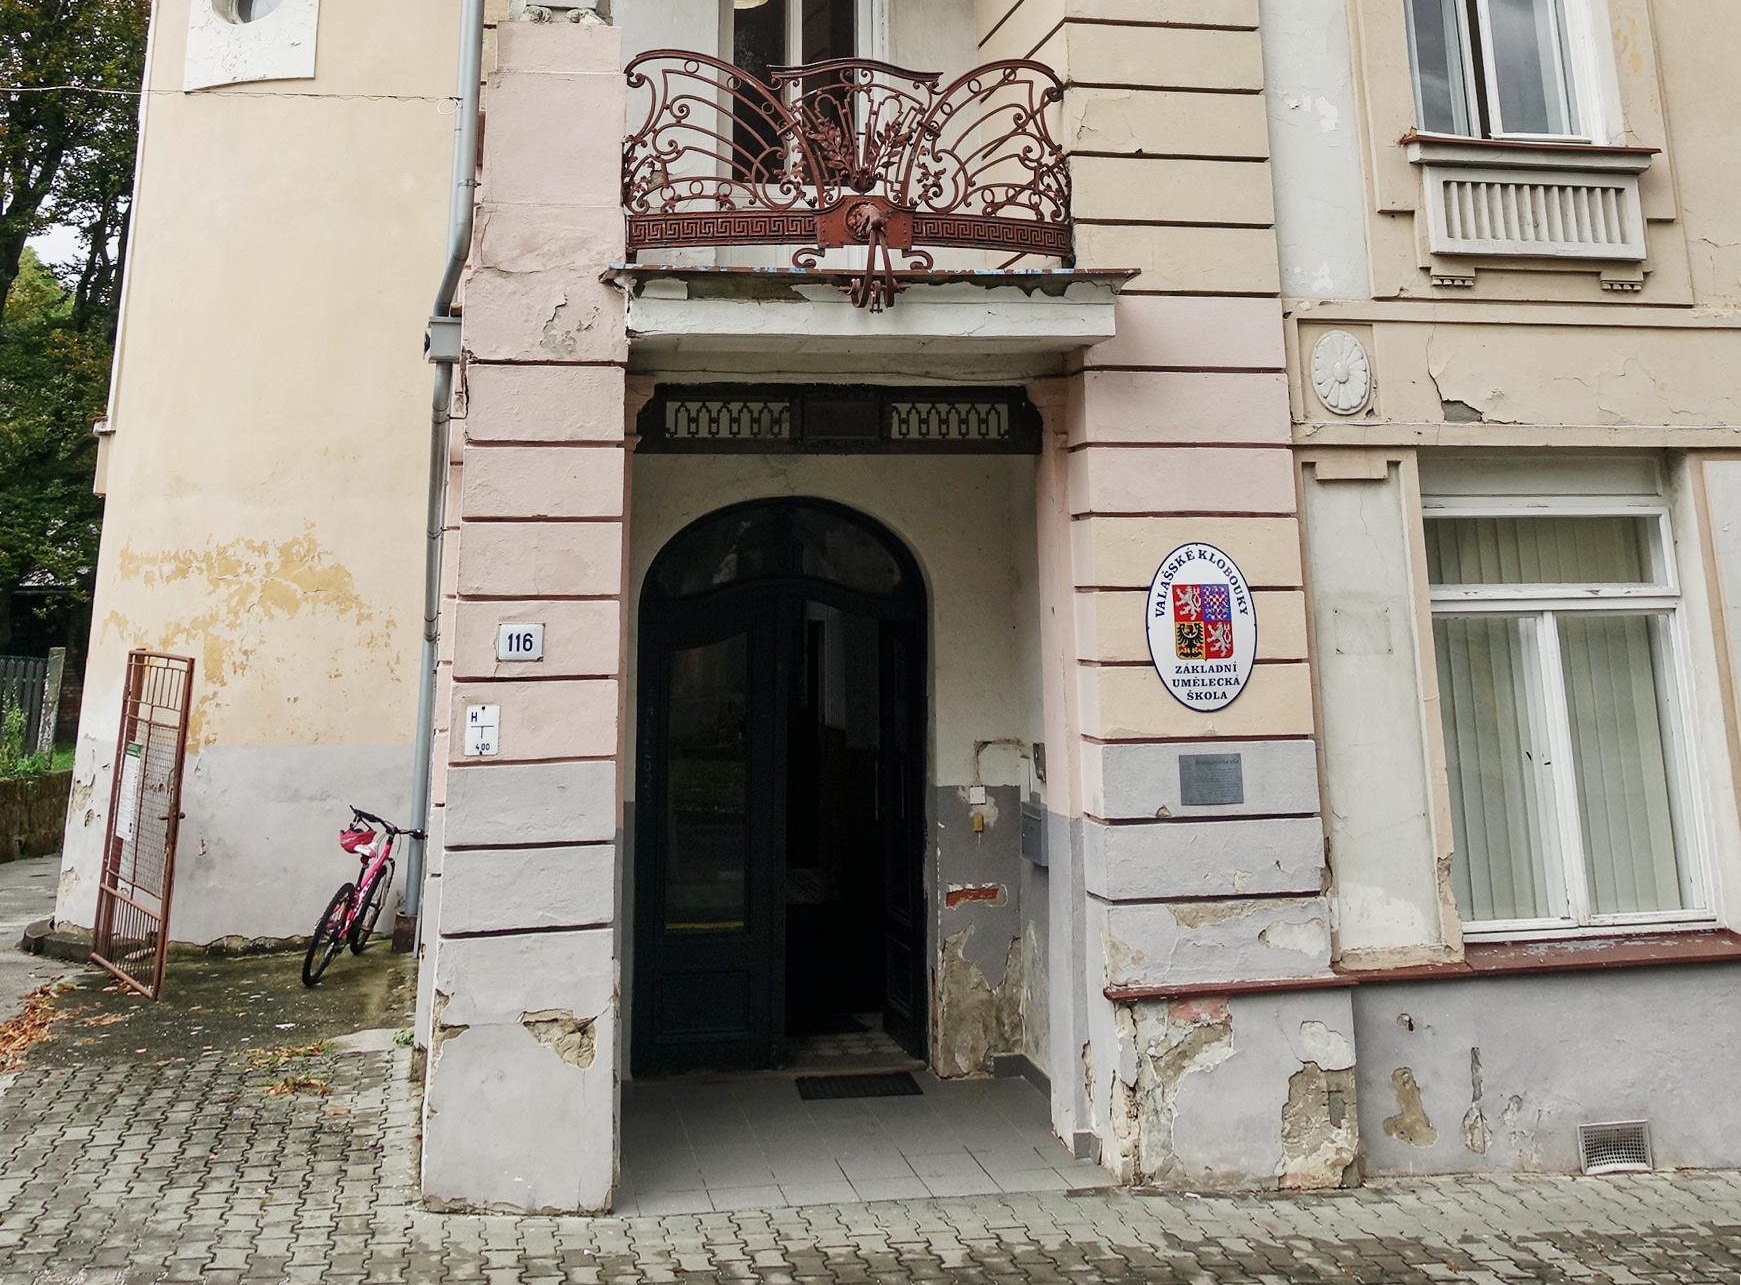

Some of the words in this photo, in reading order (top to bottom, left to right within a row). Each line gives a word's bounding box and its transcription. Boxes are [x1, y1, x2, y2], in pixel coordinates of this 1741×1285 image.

[1155, 547, 1196, 618] VALAŠSKÉ
[1198, 549, 1248, 616] KLOBOUKY
[508, 633, 533, 652] 116
[1175, 661, 1237, 674] ZÁKLADNÍ
[1172, 675, 1240, 687] UMĚLECKÁ
[1187, 689, 1228, 701] ŠKOLA
[471, 711, 478, 722] H
